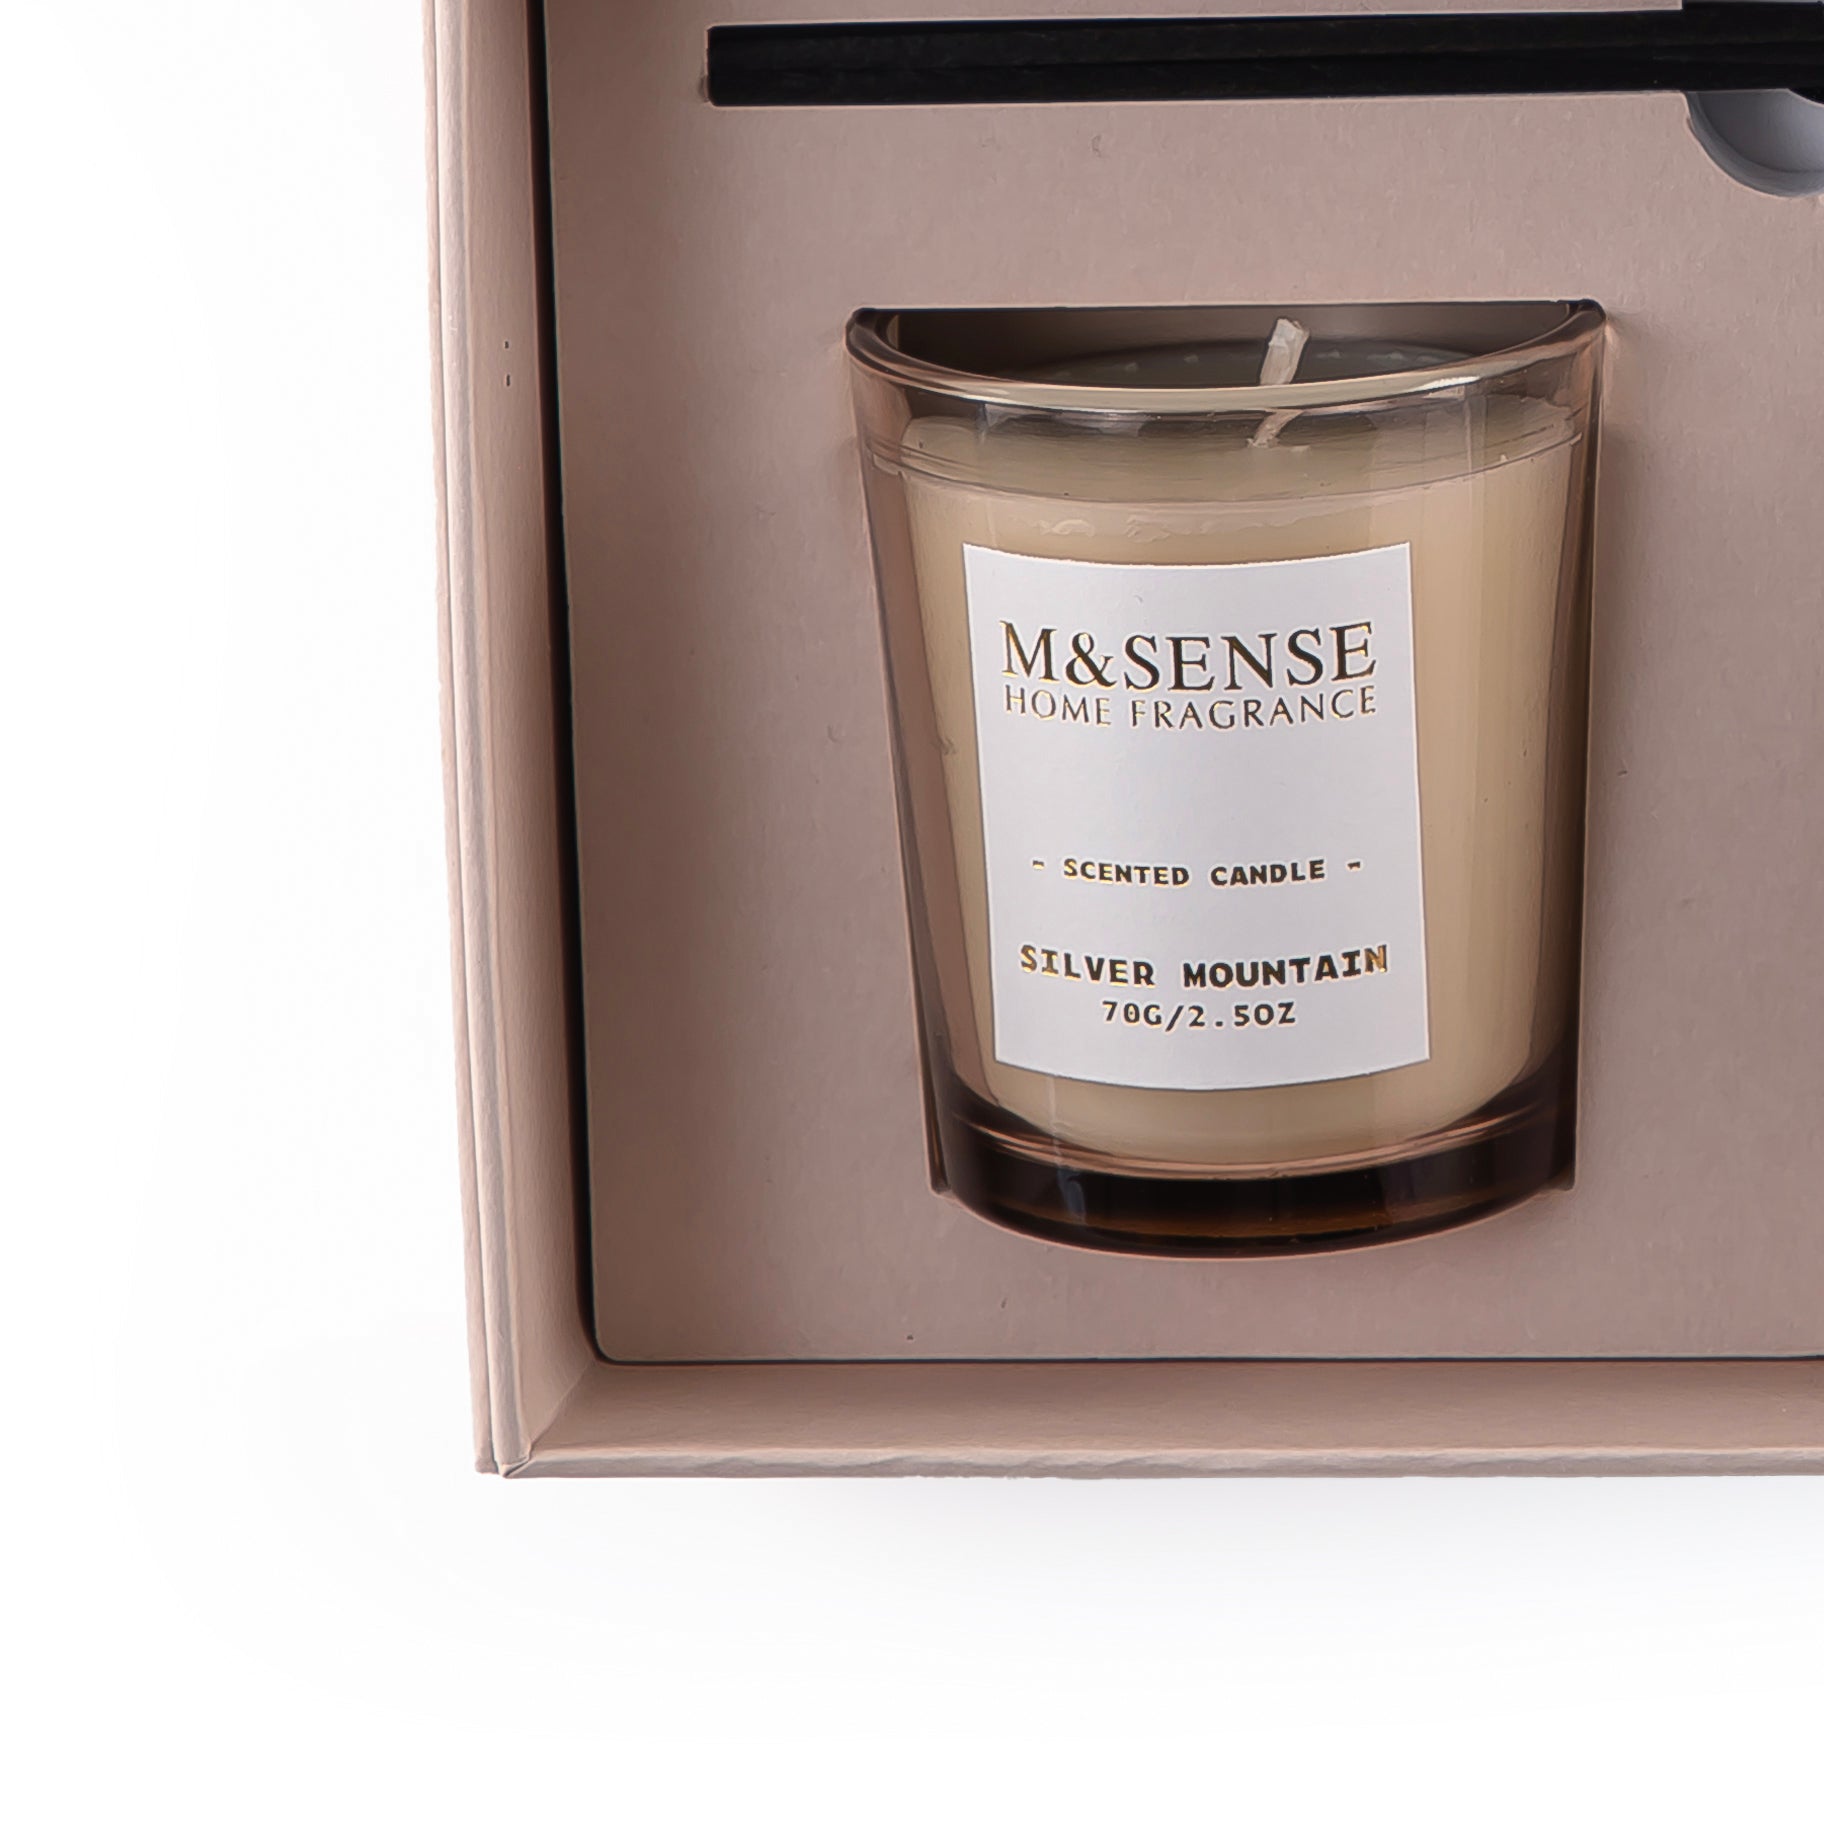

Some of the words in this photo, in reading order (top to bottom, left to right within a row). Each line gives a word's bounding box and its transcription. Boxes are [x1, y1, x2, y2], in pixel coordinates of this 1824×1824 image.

[999, 620, 1377, 693] M&SENSE
[1004, 684, 1112, 726] HOME
[1131, 684, 1377, 730] FRAGRANCE
[1063, 858, 1190, 887] SCENTED
[1210, 858, 1326, 887] CANDLE
[1020, 944, 1156, 987] SILVER
[1182, 943, 1389, 989] MOUNTAIN
[1102, 1000, 1297, 1033] 70G/2.5OZ
